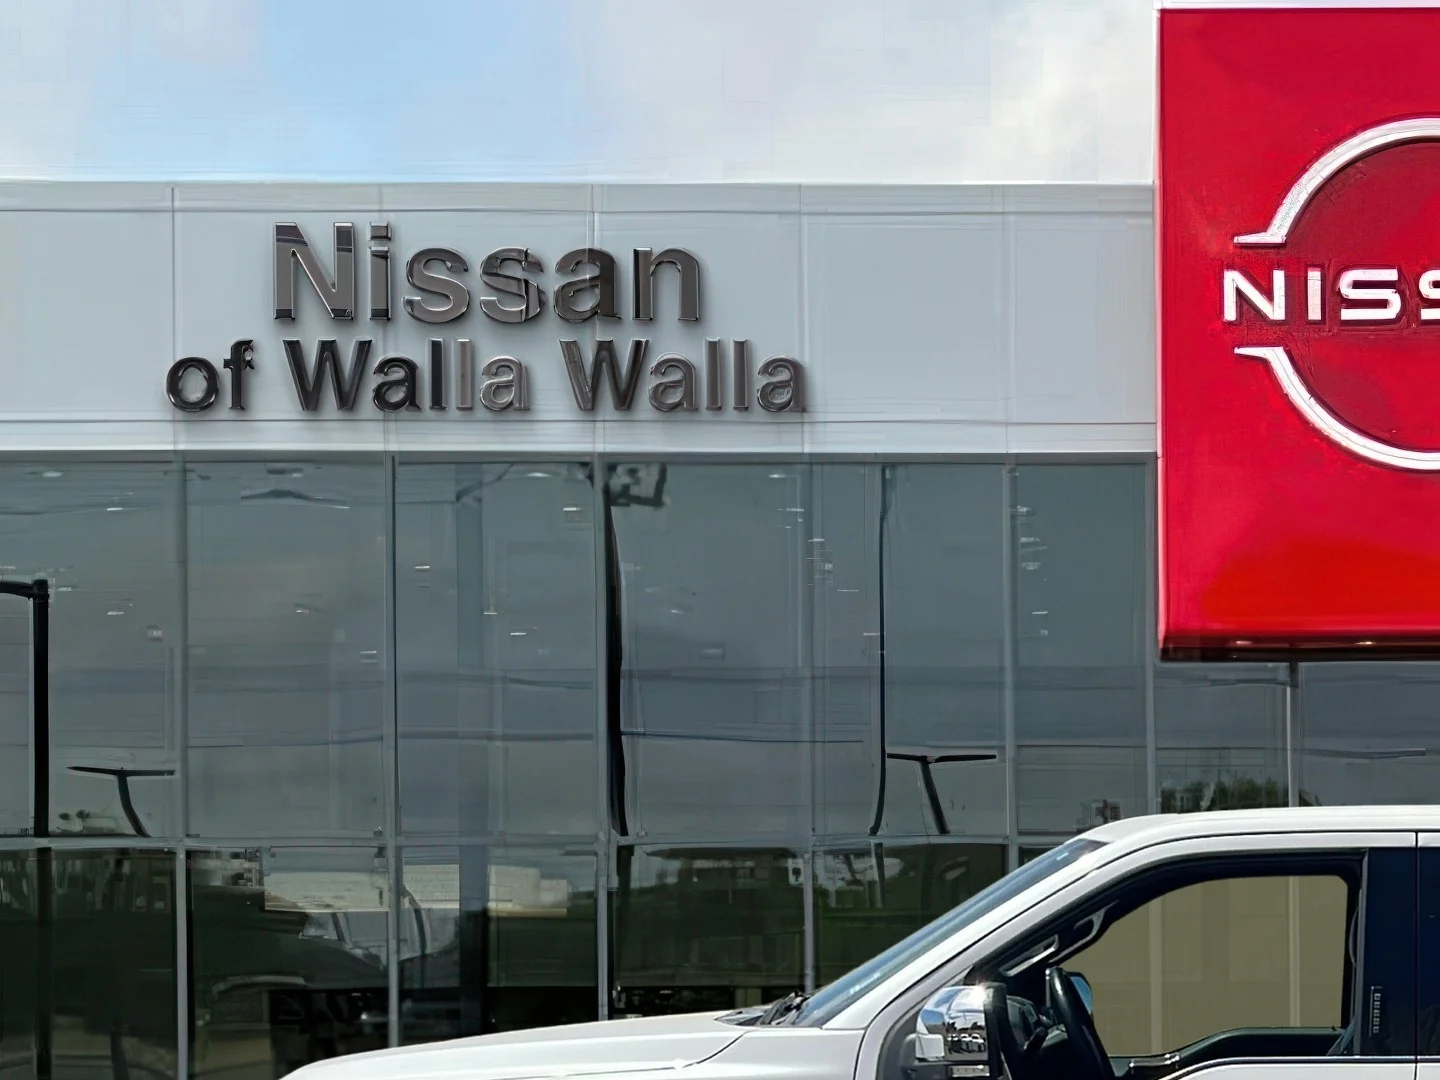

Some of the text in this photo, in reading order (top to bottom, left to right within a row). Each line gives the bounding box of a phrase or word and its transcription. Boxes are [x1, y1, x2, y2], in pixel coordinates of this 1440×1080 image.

[272, 221, 703, 322] Nissan
[166, 338, 806, 413] of Walla Walla
